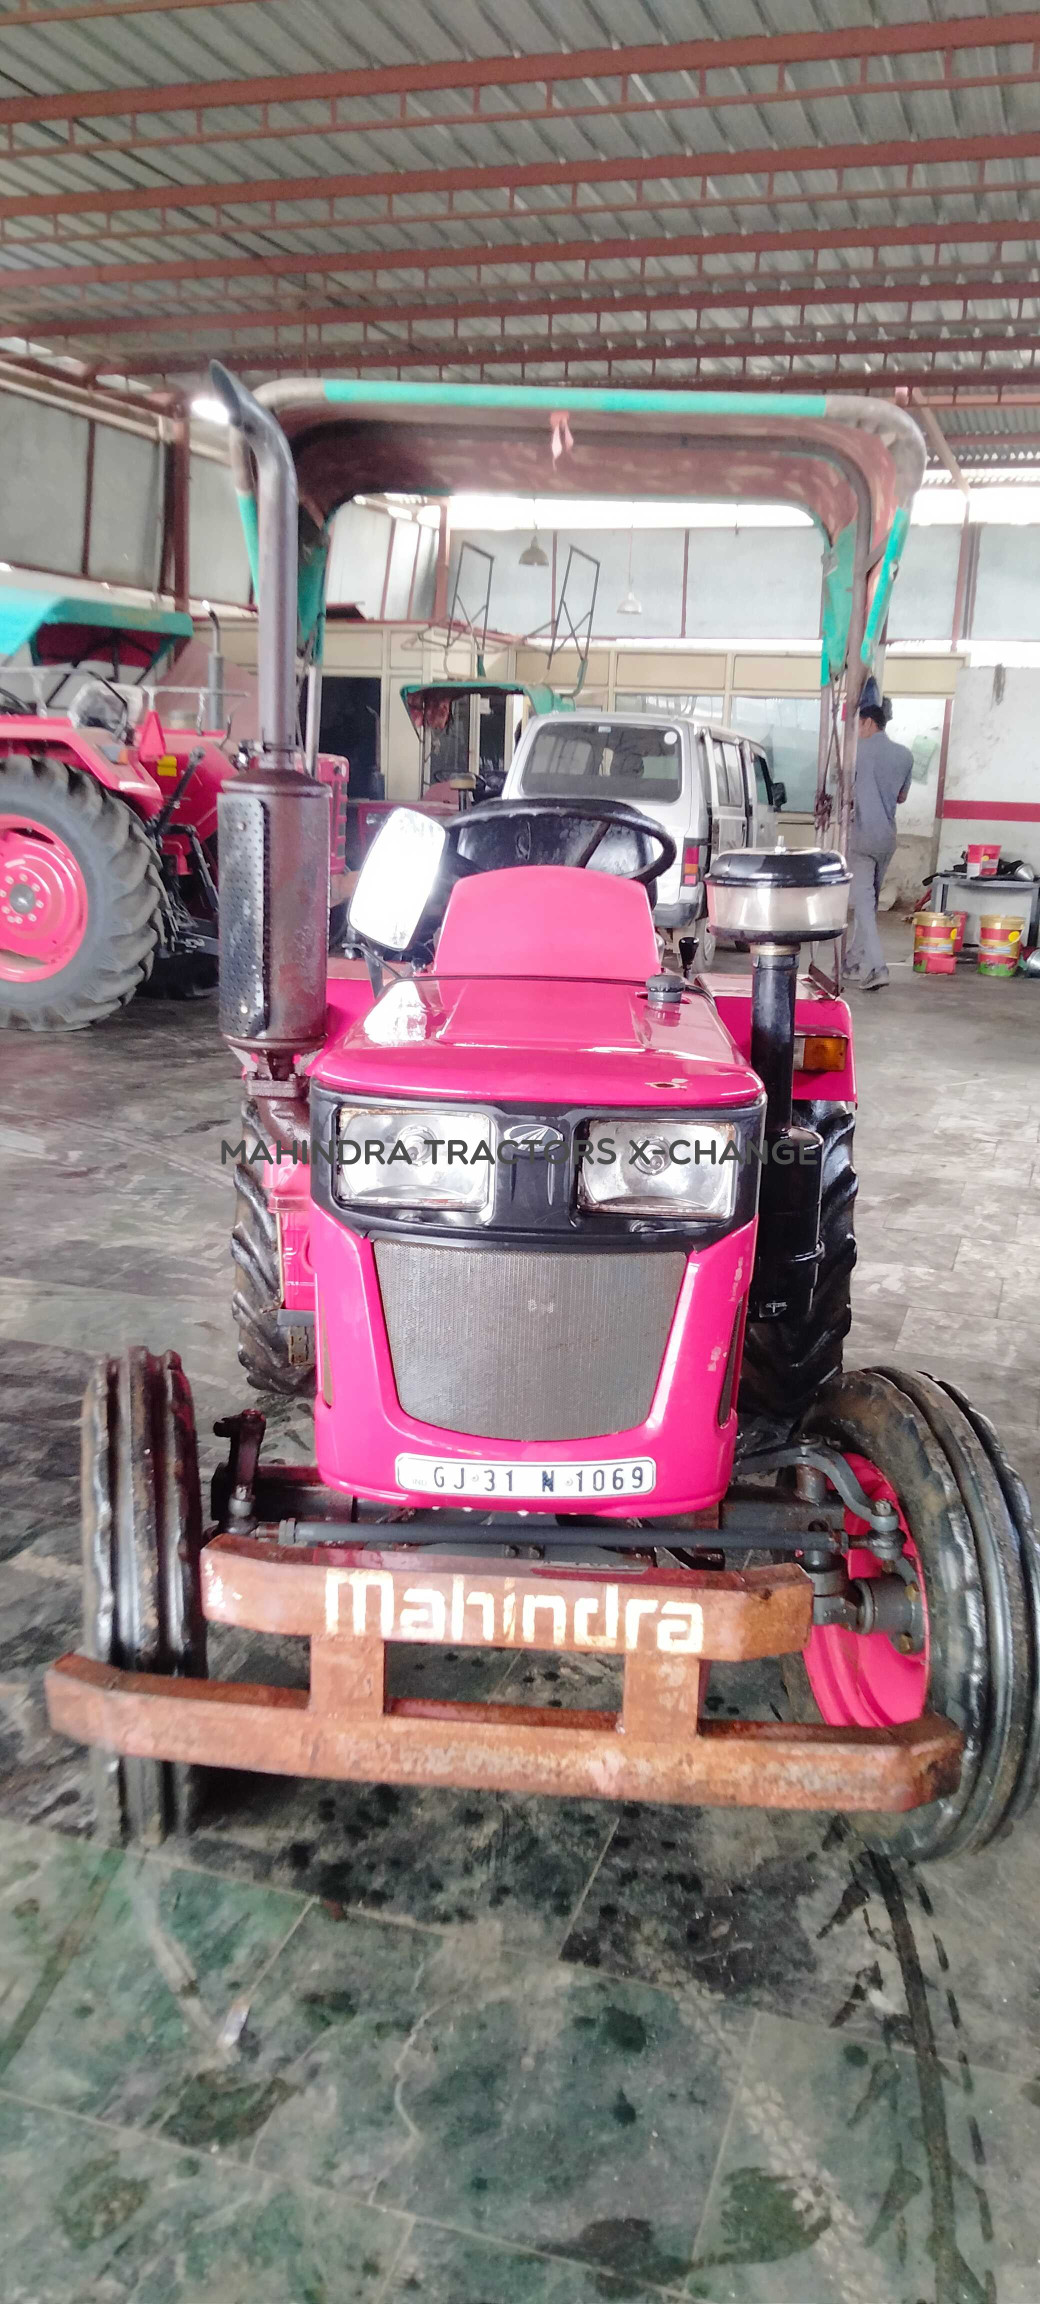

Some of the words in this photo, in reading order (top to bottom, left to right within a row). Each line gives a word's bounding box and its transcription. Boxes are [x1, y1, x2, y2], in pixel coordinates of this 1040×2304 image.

[433, 1466, 465, 1489] GJ
[484, 1469, 513, 1492] 31
[541, 1470, 555, 1492] N
[575, 1466, 644, 1492] 1069
[325, 1568, 704, 1654] Mahindra
